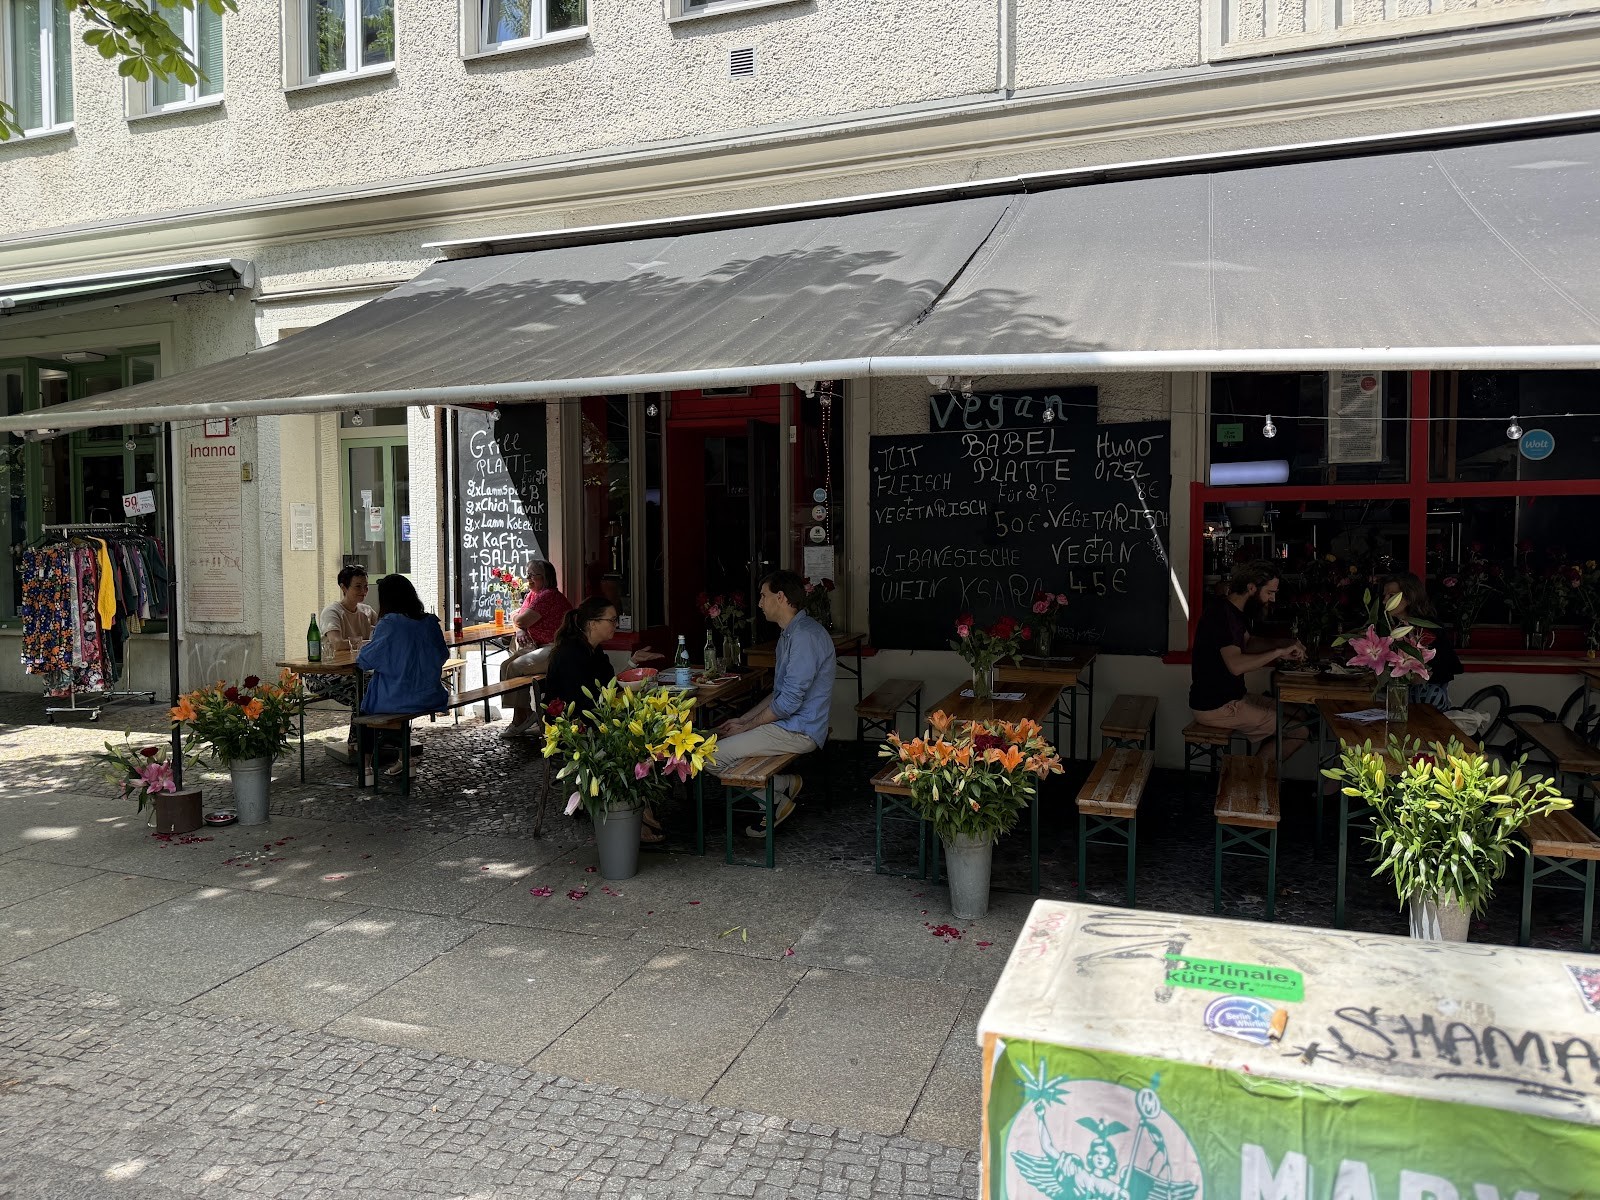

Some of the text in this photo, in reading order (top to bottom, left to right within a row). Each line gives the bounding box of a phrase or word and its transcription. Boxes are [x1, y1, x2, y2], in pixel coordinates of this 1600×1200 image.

[930, 394, 1068, 430] Vegan
[190, 444, 236, 458] Inanna
[469, 429, 521, 459] Grill
[960, 429, 1076, 459] BABEL
[1096, 431, 1164, 461] Hugo
[1525, 440, 1548, 448] Wolt
[474, 454, 532, 477] PLATTE
[973, 457, 1072, 484] PLATTE
[877, 473, 952, 497] FLEISCH
[510, 500, 545, 515] Tavuk
[875, 498, 988, 525] VEGETARISCH
[1048, 502, 1168, 533] VEGETARISCH
[479, 549, 536, 566] SALAT
[875, 544, 1022, 577] LIBANESISCHE
[1052, 537, 1141, 564] VEGAN
[881, 576, 948, 603] WEIN
[1166, 971, 1255, 992] kürzer.
[1225, 1012, 1251, 1021] Berlin
